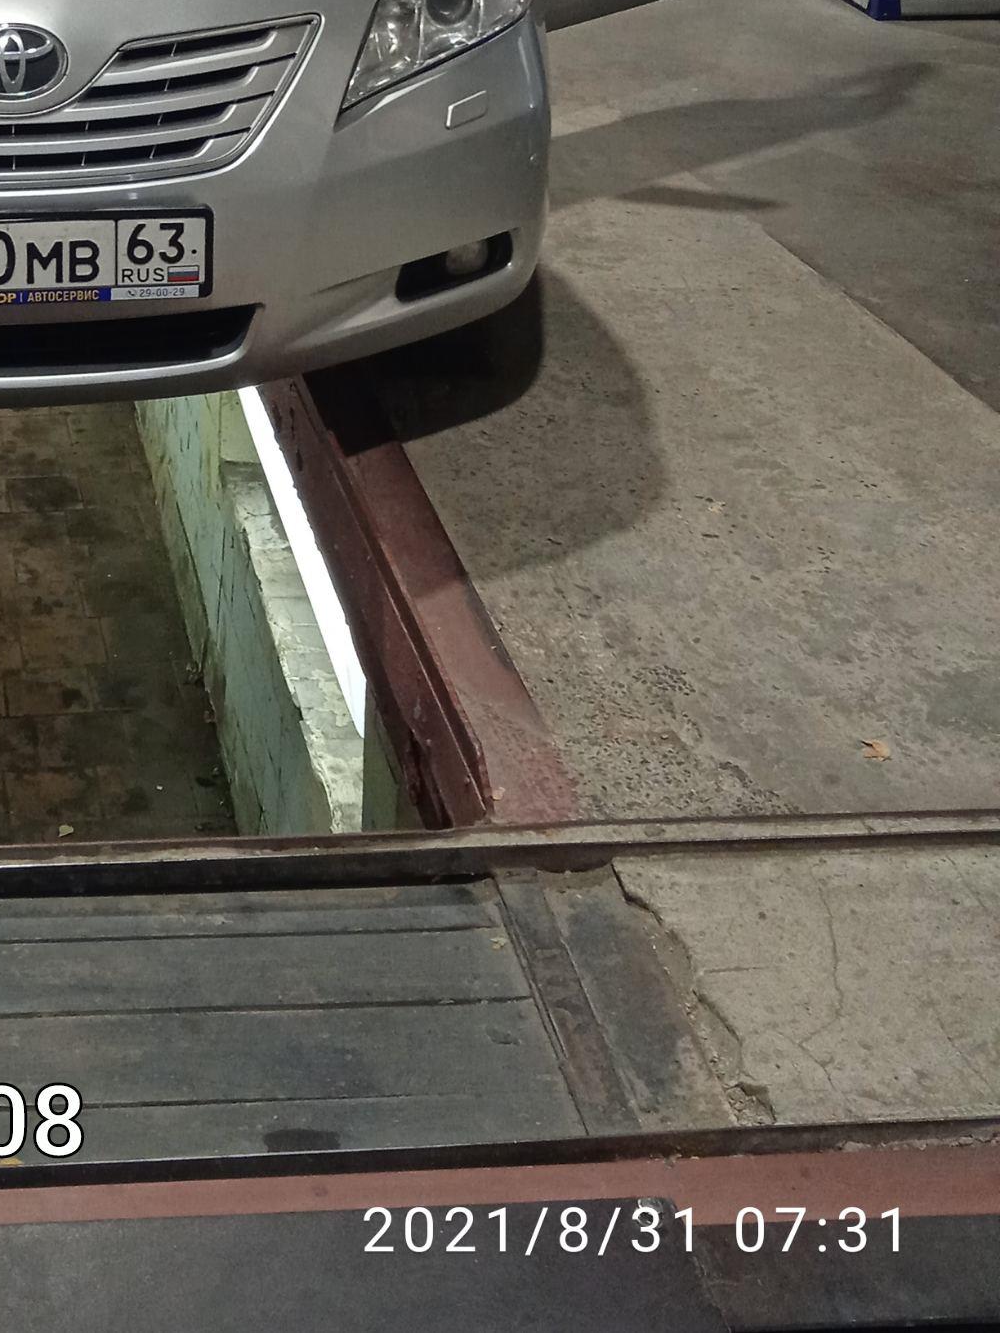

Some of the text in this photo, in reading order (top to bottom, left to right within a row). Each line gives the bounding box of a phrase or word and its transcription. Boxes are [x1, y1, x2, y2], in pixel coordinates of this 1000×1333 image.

[126, 222, 185, 266] 63
[121, 267, 165, 283] RUS
[27, 289, 100, 303] АВТОСЕРВИС
[138, 287, 186, 298] 29-00-29
